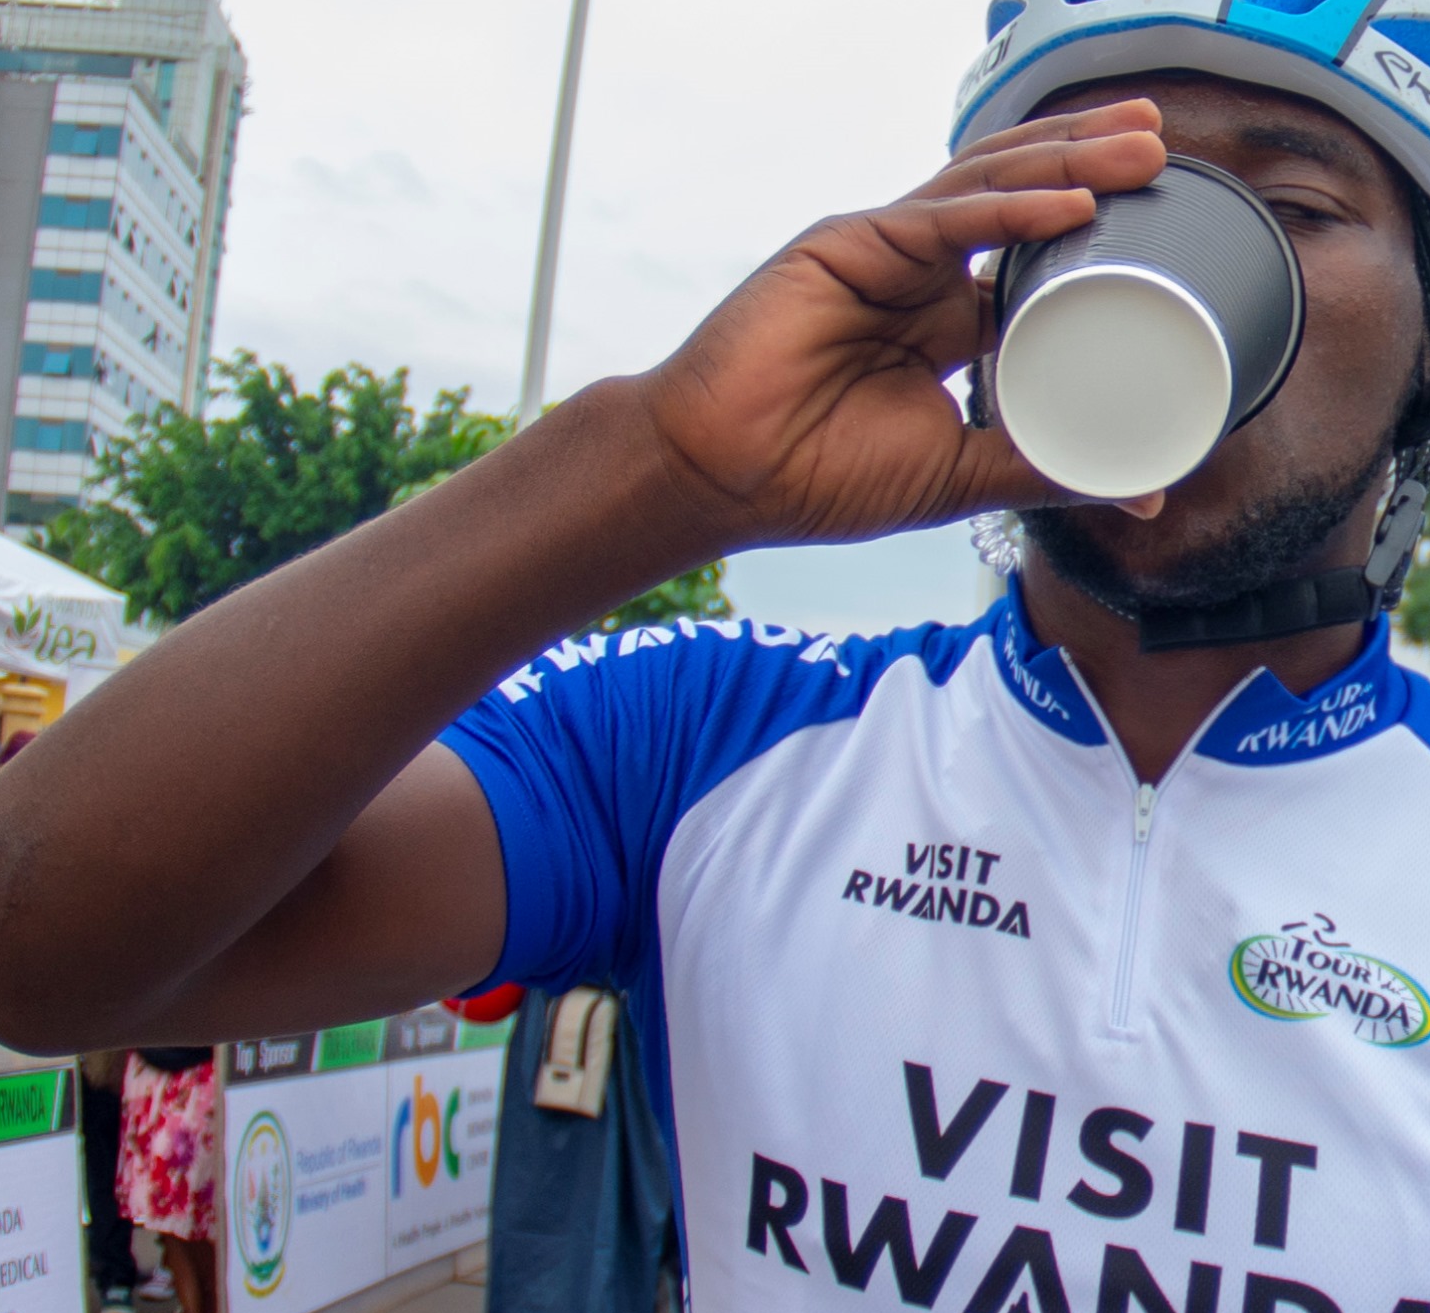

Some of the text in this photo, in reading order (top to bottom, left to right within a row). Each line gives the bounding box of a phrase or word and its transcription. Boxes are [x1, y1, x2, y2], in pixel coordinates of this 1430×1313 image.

[34, 612, 96, 665] tea
[905, 842, 1001, 886] VISIT
[841, 869, 1031, 939] RWANDA
[1256, 957, 1411, 1029] RWANDA
[1291, 935, 1372, 984] TOUR
[391, 1072, 461, 1201] rbc
[903, 1060, 1319, 1251] VISIT
